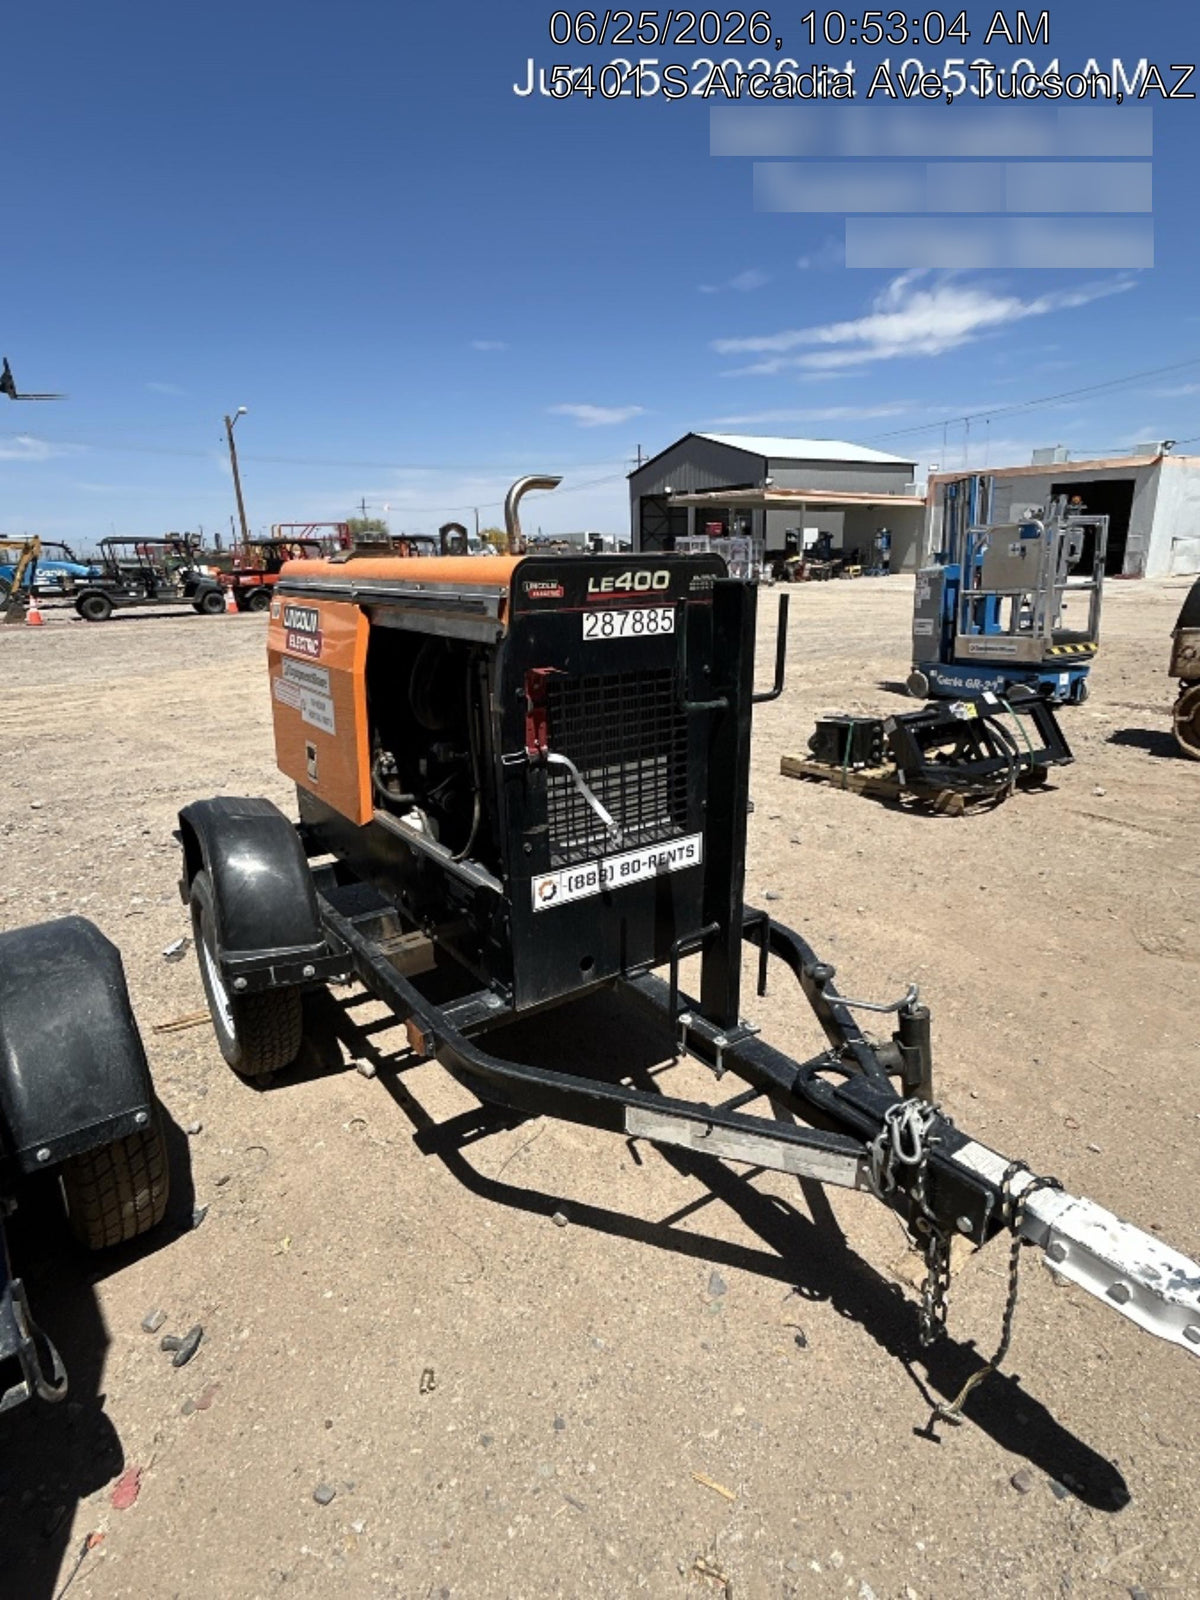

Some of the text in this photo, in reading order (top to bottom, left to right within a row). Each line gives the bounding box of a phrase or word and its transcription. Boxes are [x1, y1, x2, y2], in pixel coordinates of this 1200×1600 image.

[588, 569, 670, 593] LE400
[284, 608, 318, 632] LINCOLN
[585, 608, 673, 638] 287885
[289, 634, 319, 654] ELECTRIC
[567, 844, 695, 893] (888) 80-RENTS
